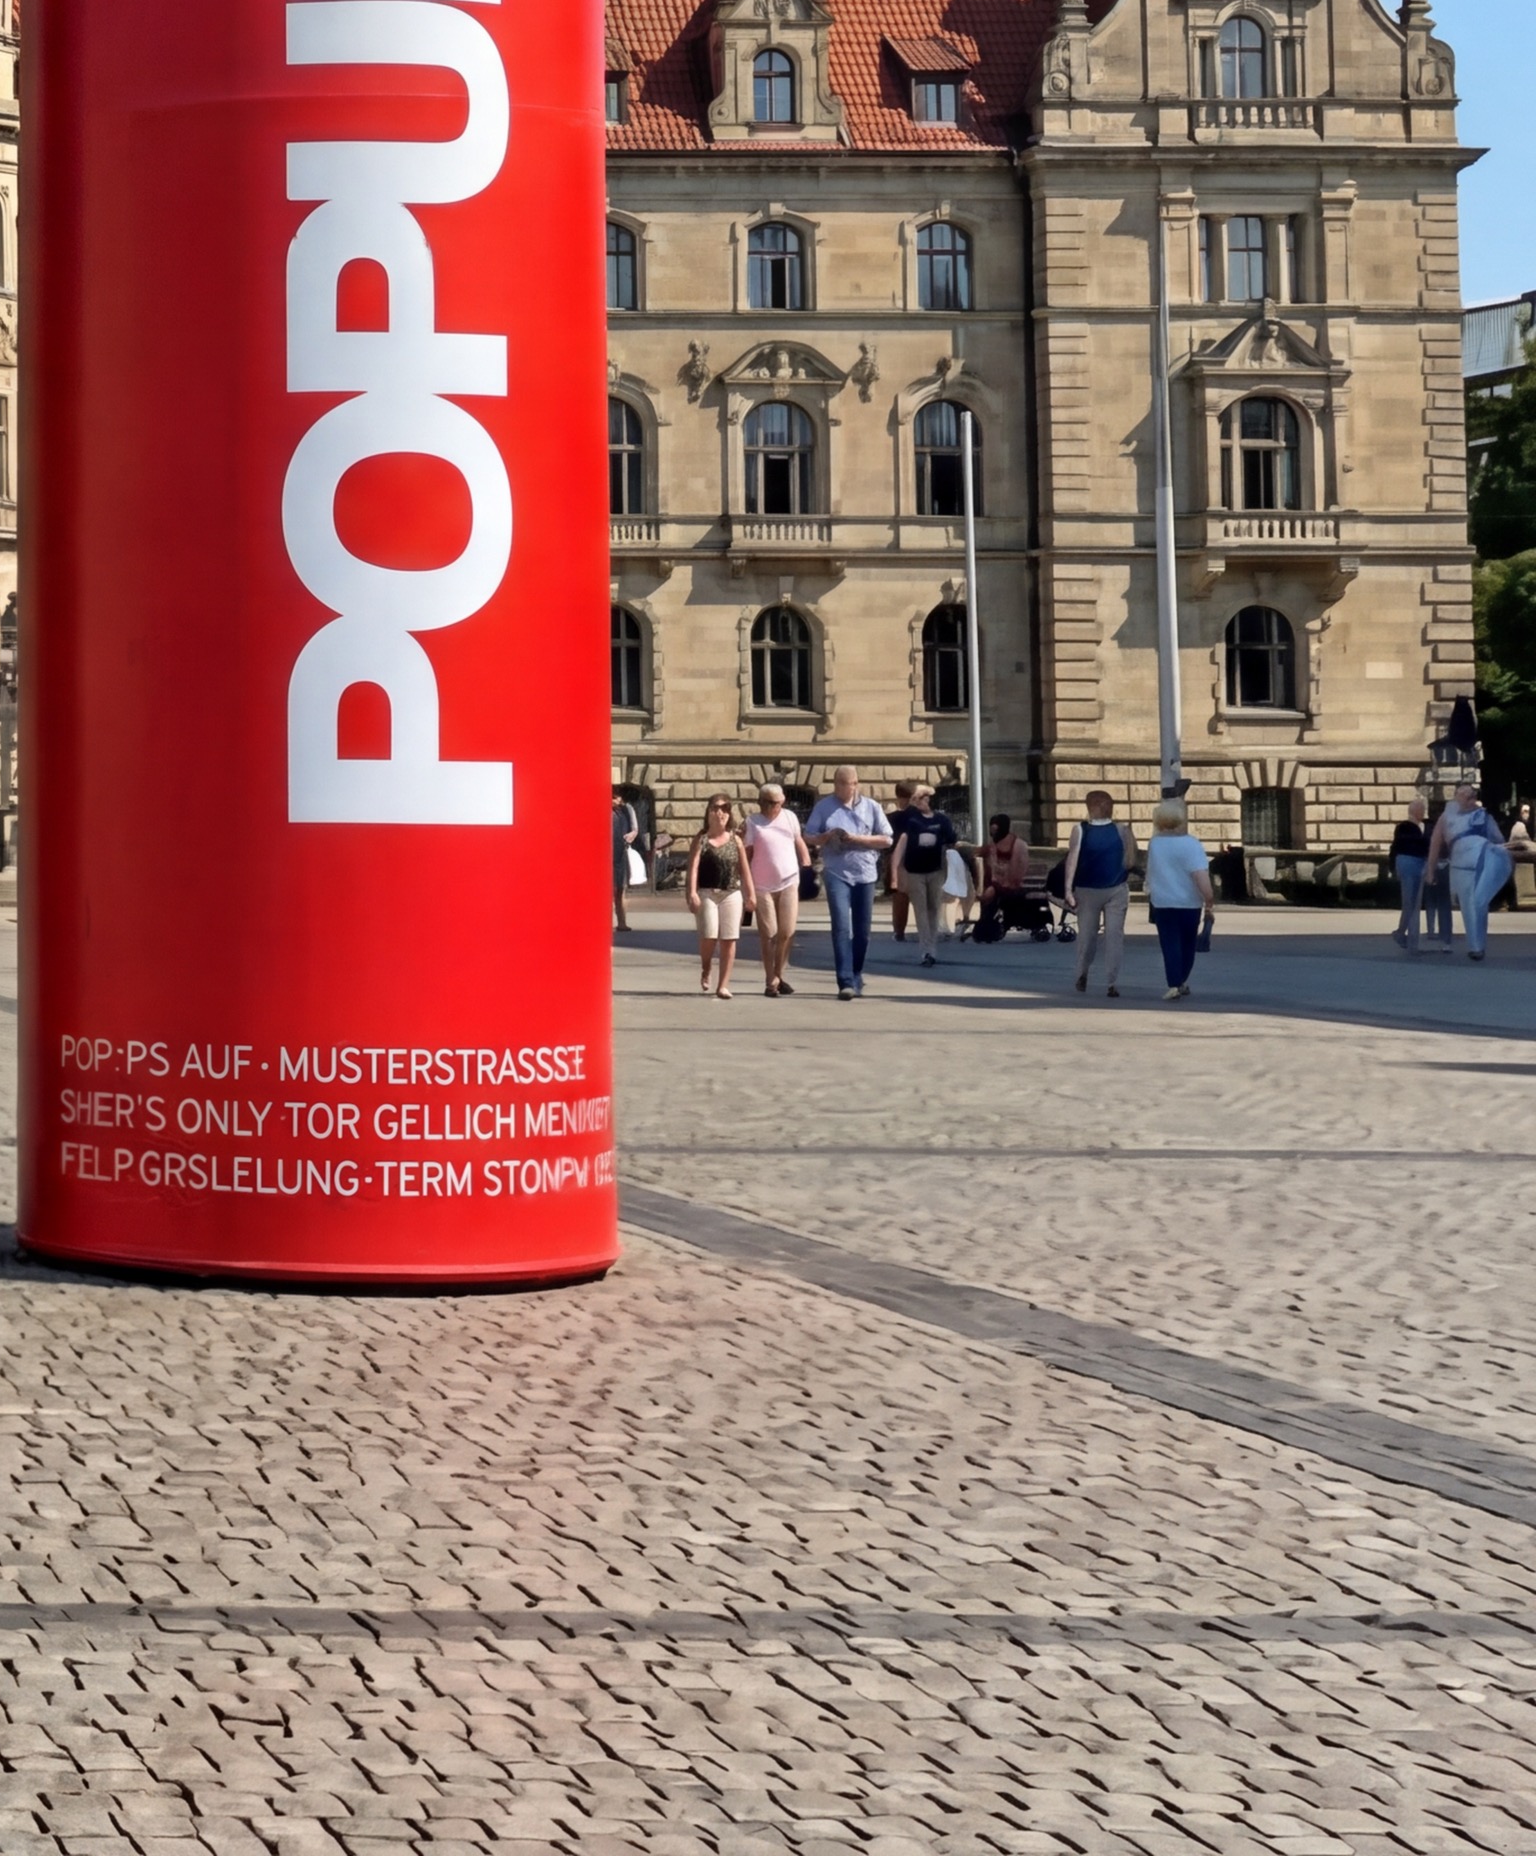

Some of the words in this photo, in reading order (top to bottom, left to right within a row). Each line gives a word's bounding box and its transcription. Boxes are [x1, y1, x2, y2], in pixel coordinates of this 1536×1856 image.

[181, 1043, 253, 1080] AUF
[60, 1089, 166, 1132] SHER'S
[177, 1098, 273, 1137] ONLY
[284, 1102, 360, 1140] TOR
[373, 1103, 516, 1141] GELLICH
